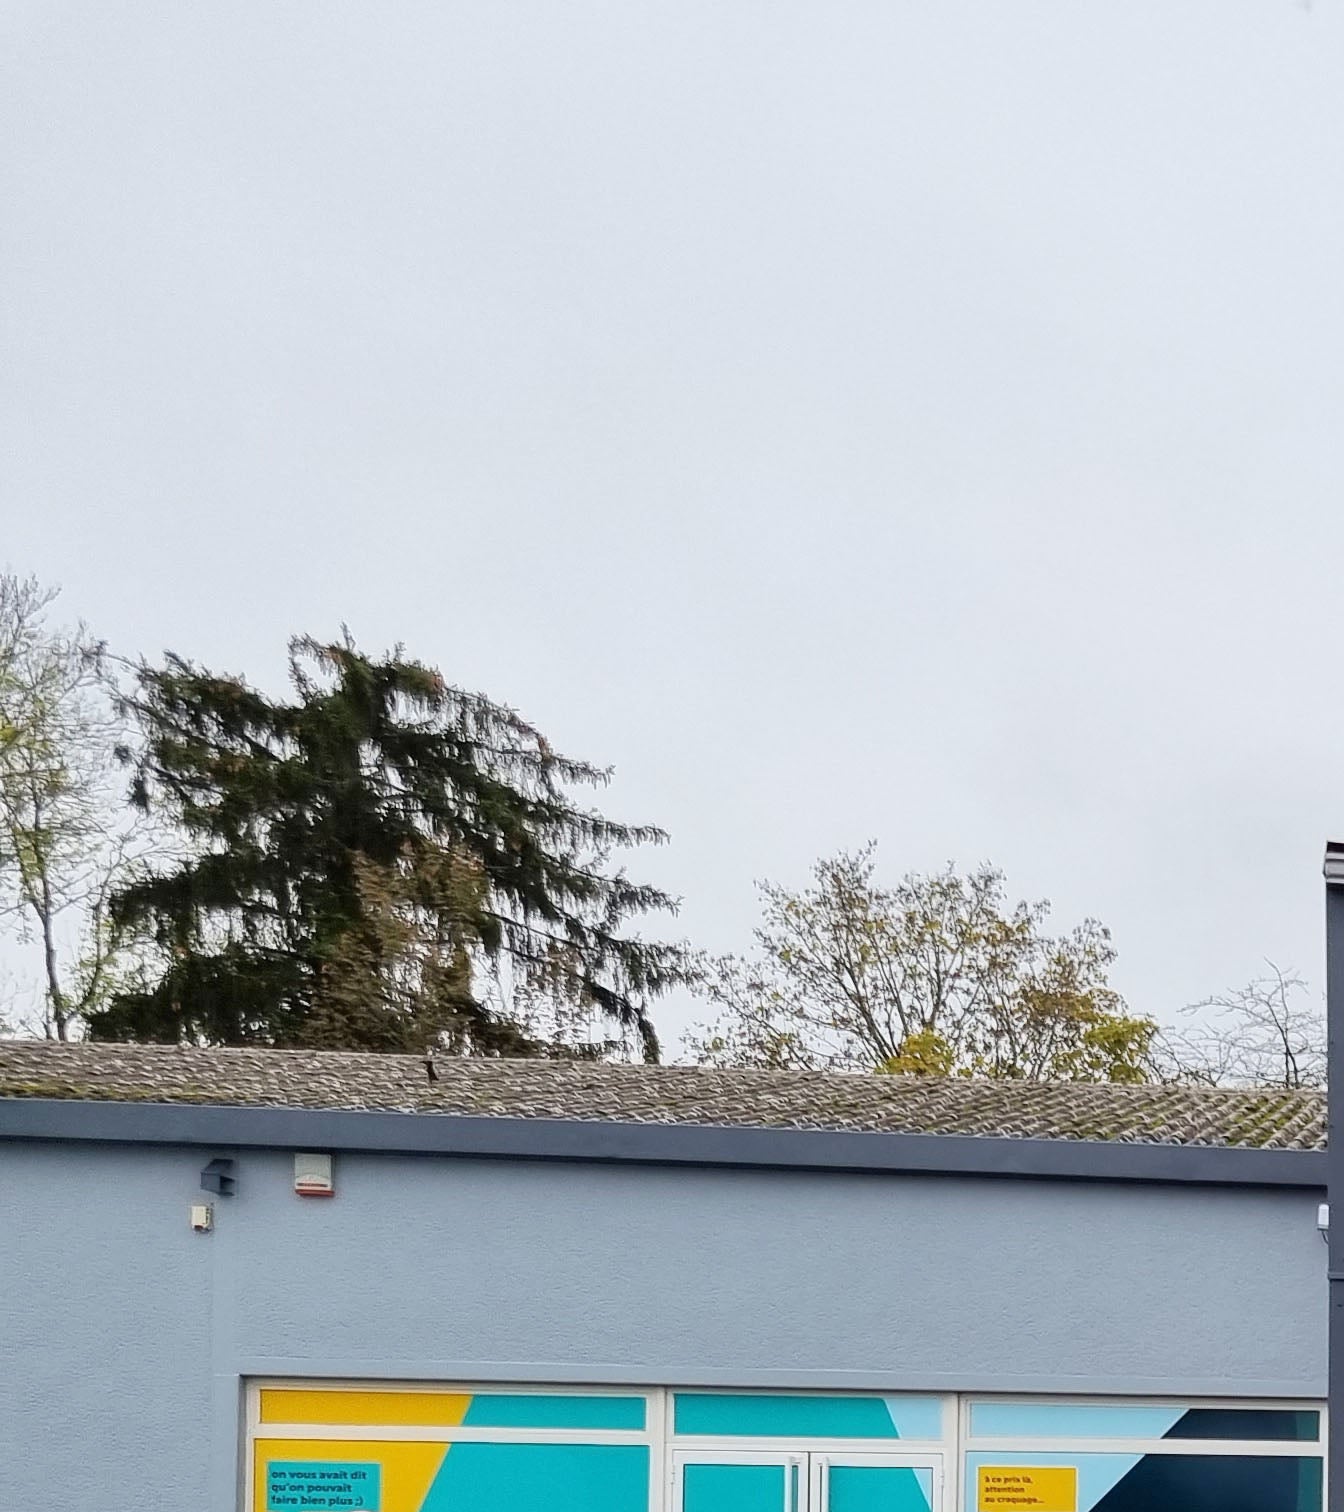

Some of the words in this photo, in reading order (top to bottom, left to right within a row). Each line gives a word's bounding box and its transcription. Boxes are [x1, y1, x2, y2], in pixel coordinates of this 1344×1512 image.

[271, 1471, 286, 1479] on
[319, 1471, 348, 1479] avait
[350, 1471, 367, 1480] dit
[271, 1483, 304, 1493] qu'on
[307, 1484, 352, 1493] pouvait
[271, 1495, 298, 1504] faire
[301, 1496, 326, 1505] bien
[328, 1496, 353, 1507] plus
